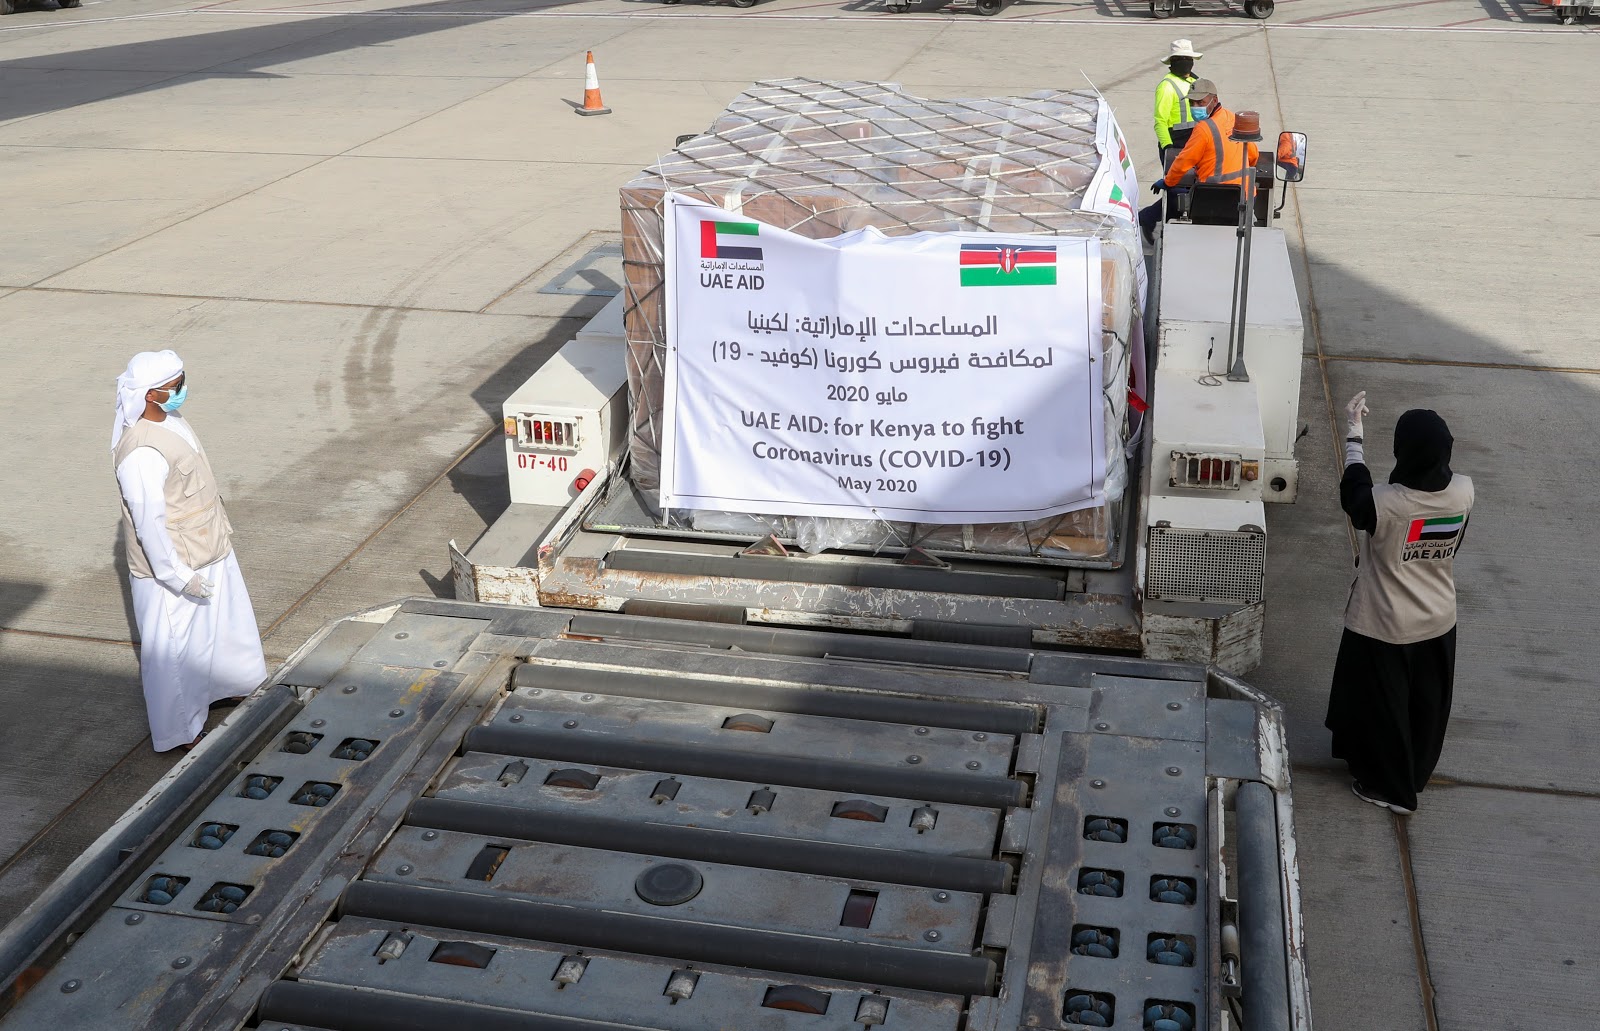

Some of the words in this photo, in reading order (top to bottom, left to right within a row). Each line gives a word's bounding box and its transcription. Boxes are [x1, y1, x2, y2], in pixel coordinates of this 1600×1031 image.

[700, 260, 728, 272] الإماراتية
[728, 262, 765, 272] المساعدات
[700, 273, 734, 289] UAE
[736, 274, 765, 290] AID
[747, 310, 788, 334] لكينيا
[795, 315, 877, 342] الإماراتية:
[885, 315, 998, 338] المساعدات
[824, 349, 882, 373] كورونا
[889, 352, 960, 373] فيروس
[968, 347, 1053, 368] لمكافحة
[827, 384, 869, 402] 2020
[875, 386, 908, 405] مايو
[740, 410, 781, 430] UAE
[787, 414, 829, 434] AID:
[833, 416, 864, 436] for
[870, 419, 936, 441] Kenya
[941, 420, 965, 436] to
[971, 416, 1025, 440] fight
[518, 454, 567, 471] 07-40
[752, 441, 873, 467] Coronavirus
[879, 447, 1011, 472] (COVID-19)
[838, 476, 871, 493] May
[876, 478, 917, 493] 2020
[1402, 550, 1430, 561] UAE
[1431, 547, 1453, 559] AID
